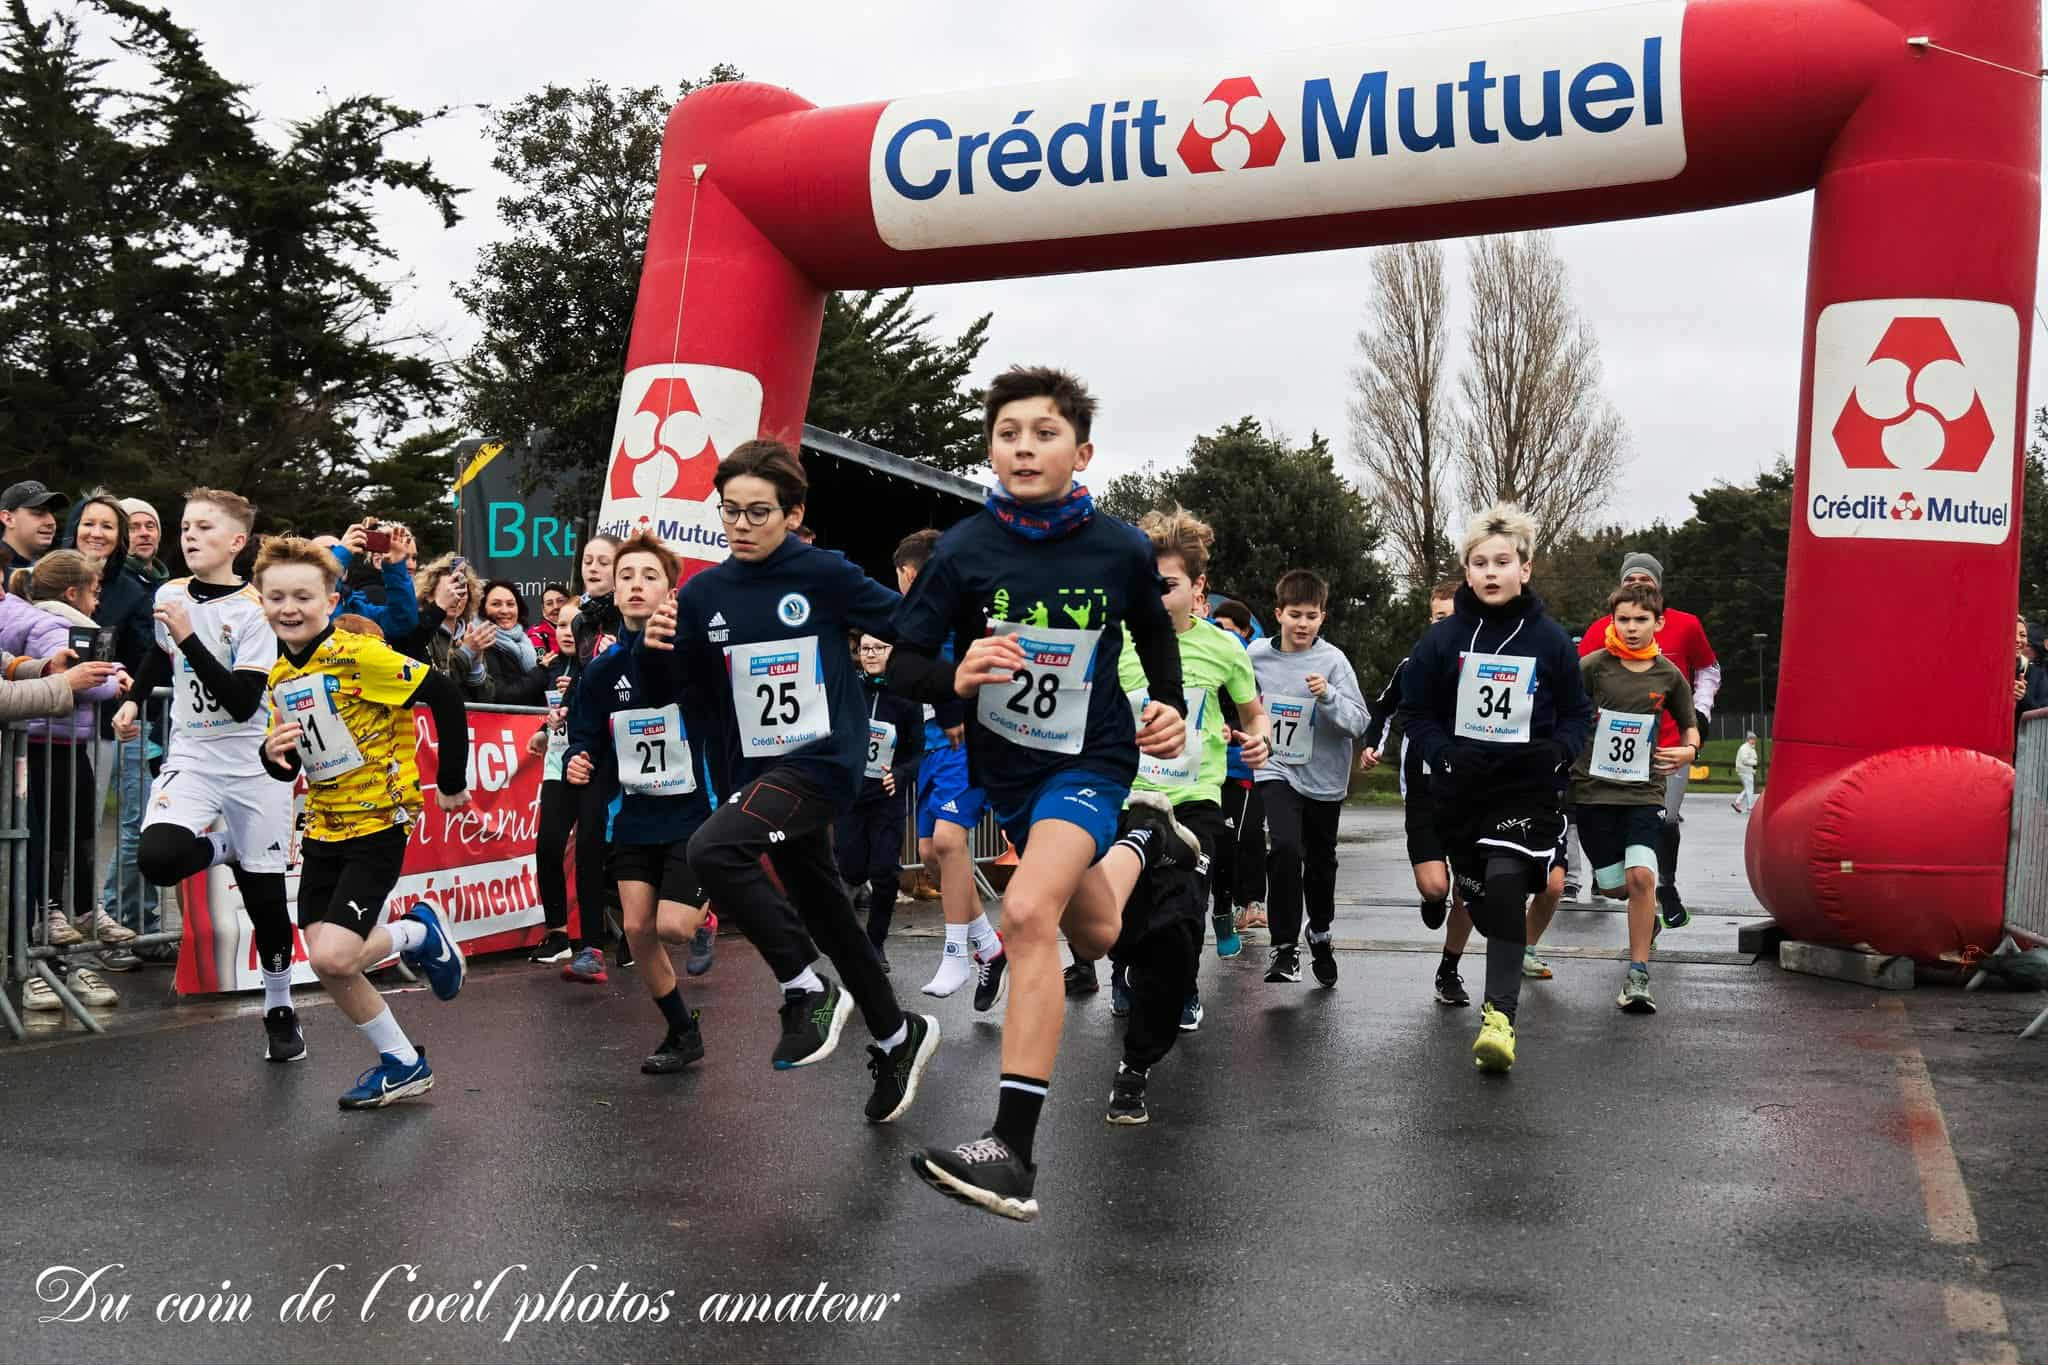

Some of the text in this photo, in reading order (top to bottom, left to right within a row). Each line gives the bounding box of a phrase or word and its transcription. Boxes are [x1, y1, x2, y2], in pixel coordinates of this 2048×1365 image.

[885, 36, 1662, 201] Crédit Mutuel
[1812, 494, 2008, 526] Crédit Mutuel
[656, 519, 729, 549] Mutue
[190, 679, 220, 713] 39
[757, 682, 800, 726] 25
[1006, 668, 1060, 719] 28
[1477, 685, 1512, 720] 34
[751, 735, 775, 746] Crédit
[1030, 727, 1069, 741] Mutuel
[1272, 719, 1298, 747] 17
[636, 739, 666, 774] 27
[1608, 736, 1636, 763] 38
[161, 770, 180, 790] 7
